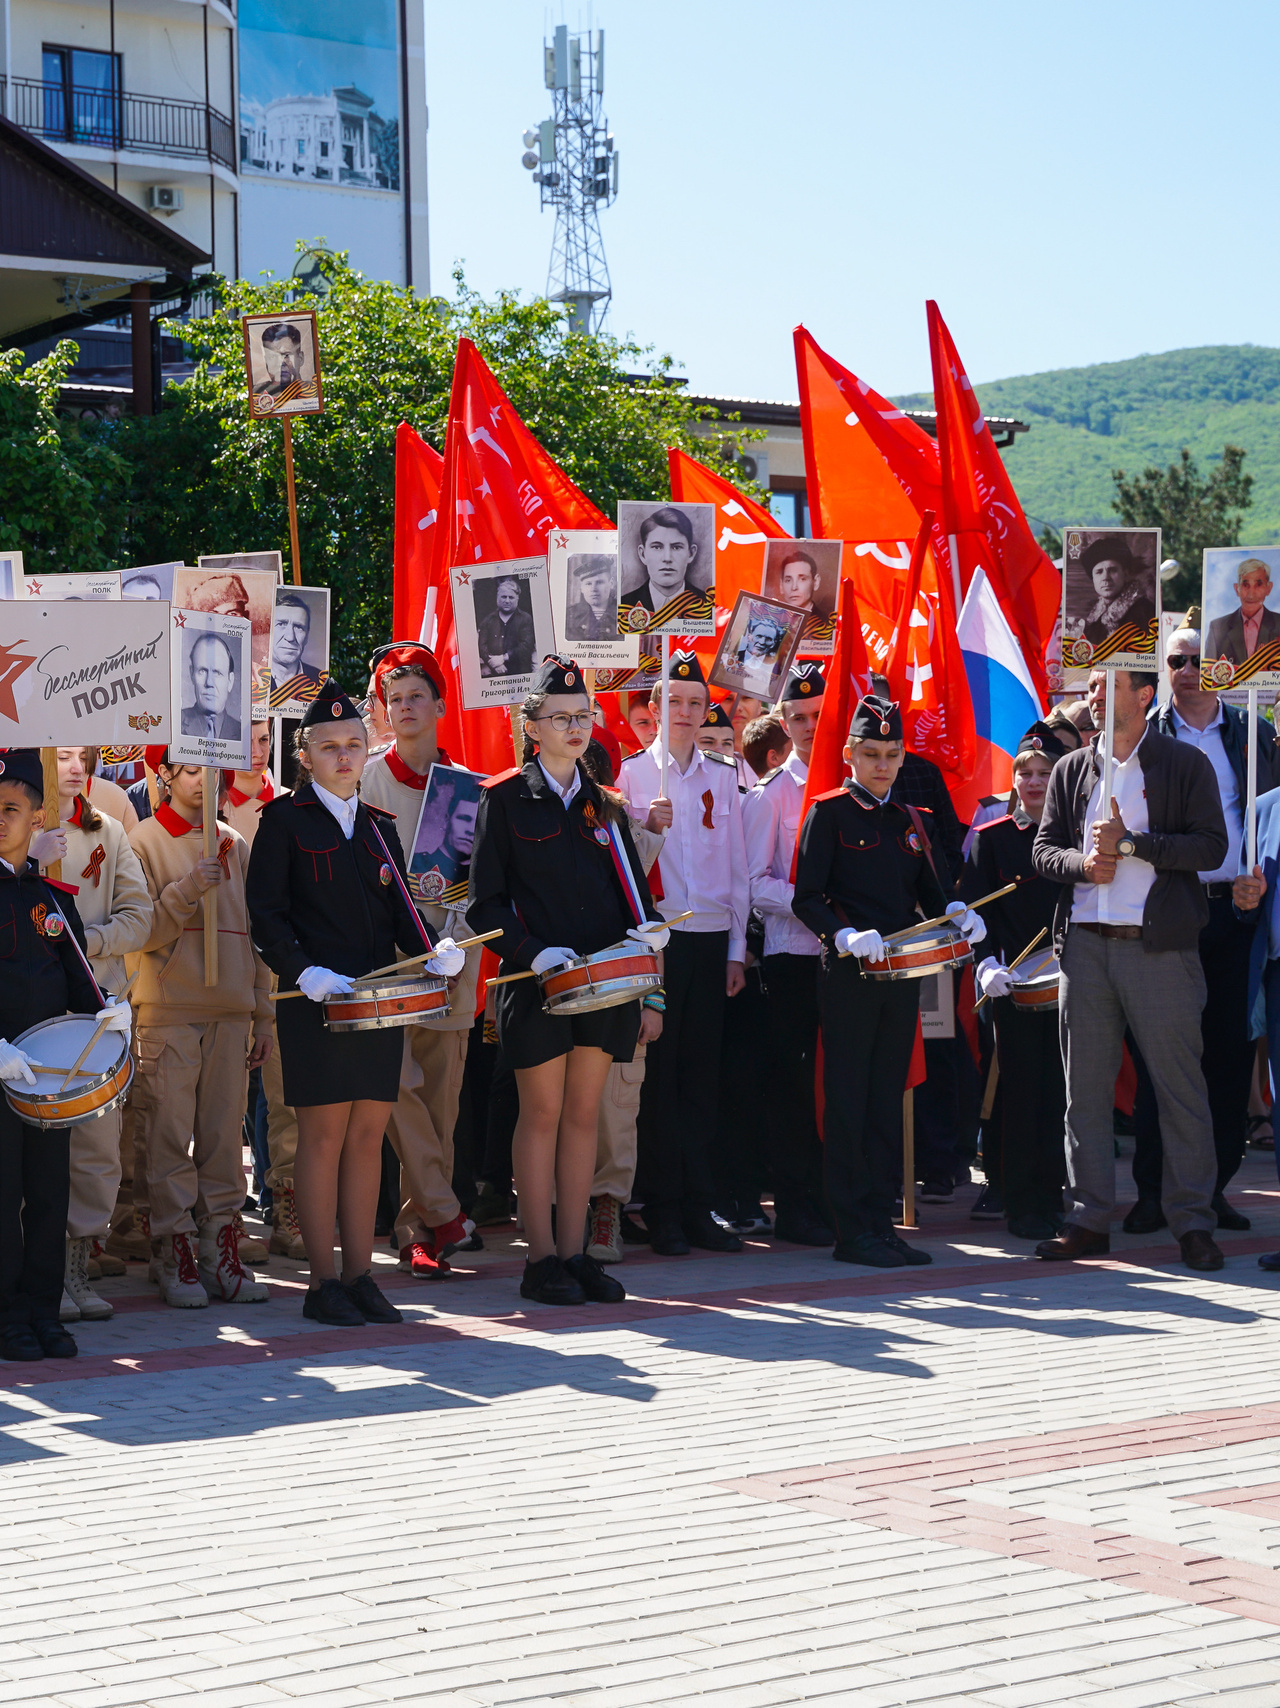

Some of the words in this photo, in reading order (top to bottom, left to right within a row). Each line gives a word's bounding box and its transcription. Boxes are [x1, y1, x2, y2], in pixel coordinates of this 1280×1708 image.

[227, 630, 244, 638] ПОЛК
[1123, 661, 1156, 669] Иванович
[489, 676, 531, 686] Тектаниди
[71, 672, 147, 718] ПОЛК
[481, 687, 516, 698] Григорий
[197, 738, 228, 749] Вергунов
[178, 747, 202, 757] Леонид
[202, 748, 247, 761] Никифорович
